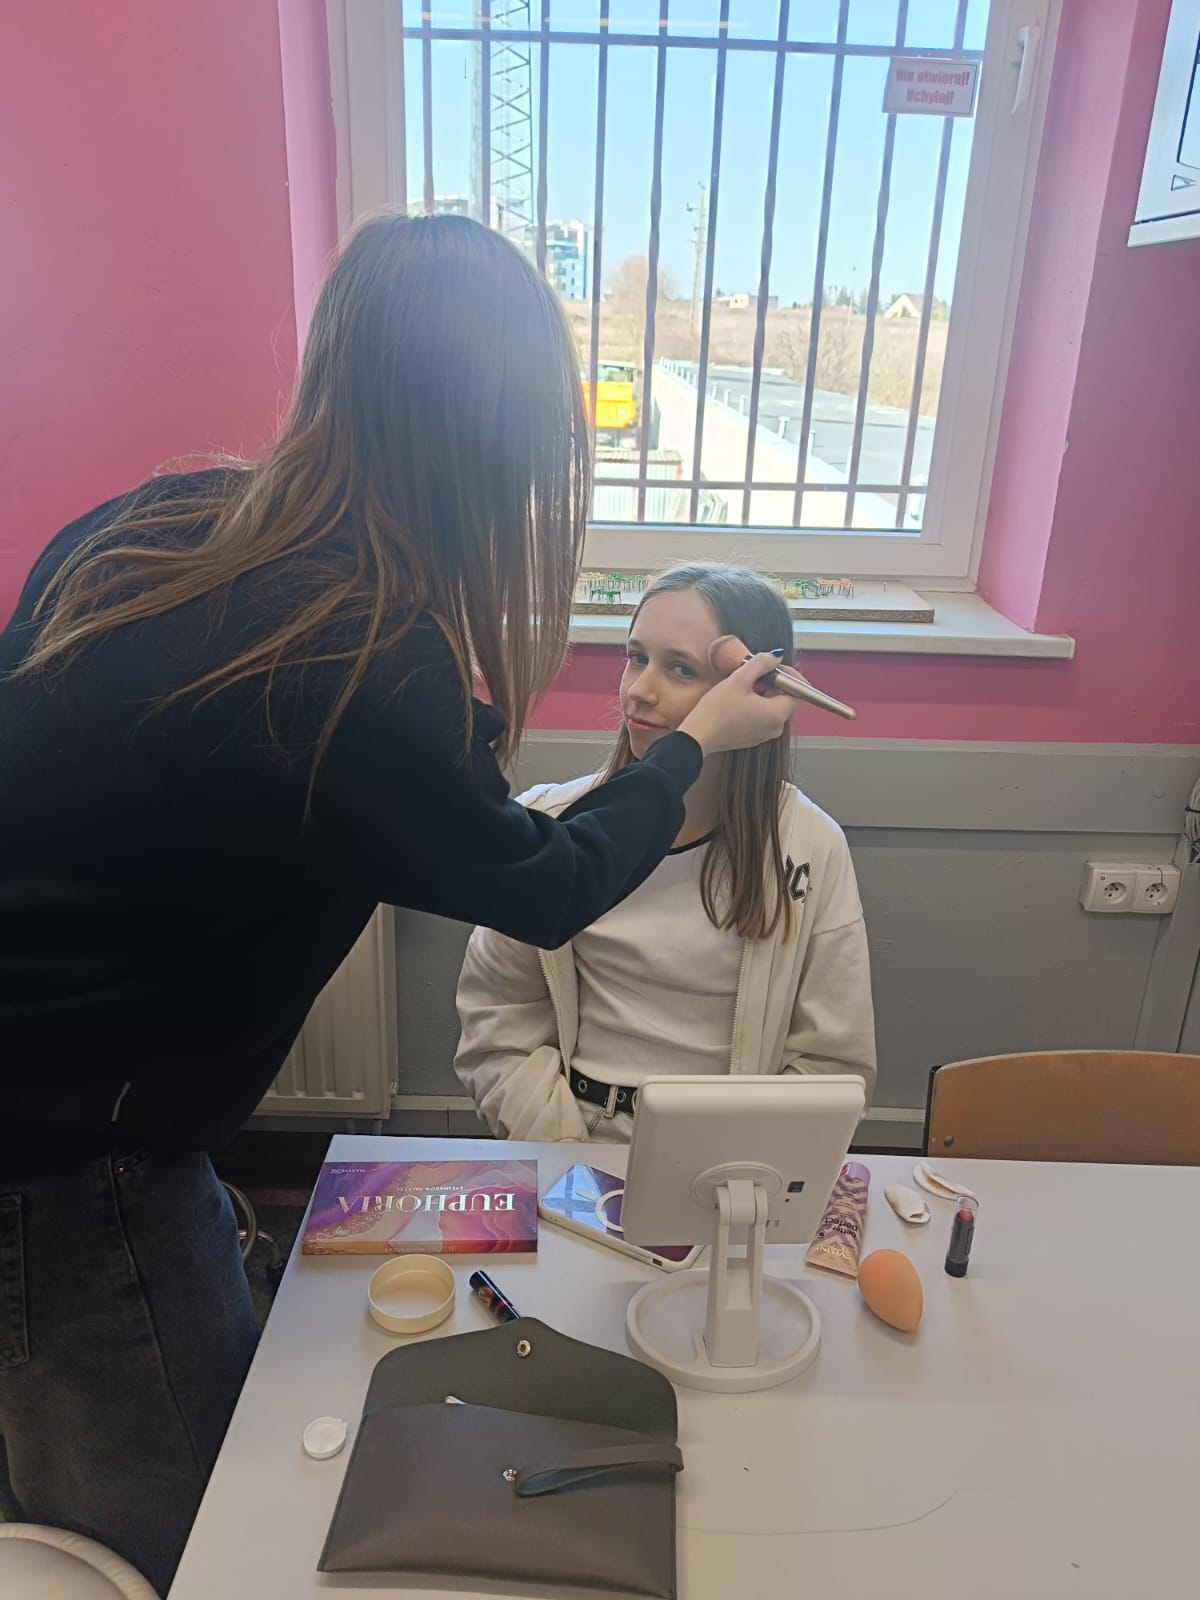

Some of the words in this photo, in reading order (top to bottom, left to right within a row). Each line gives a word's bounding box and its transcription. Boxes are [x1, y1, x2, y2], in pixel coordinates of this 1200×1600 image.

[896, 68, 914, 82] Nie
[917, 70, 970, 87] otwieraj!
[336, 1193, 516, 1214] EUPHORIA
[824, 1217, 858, 1233] perfect
